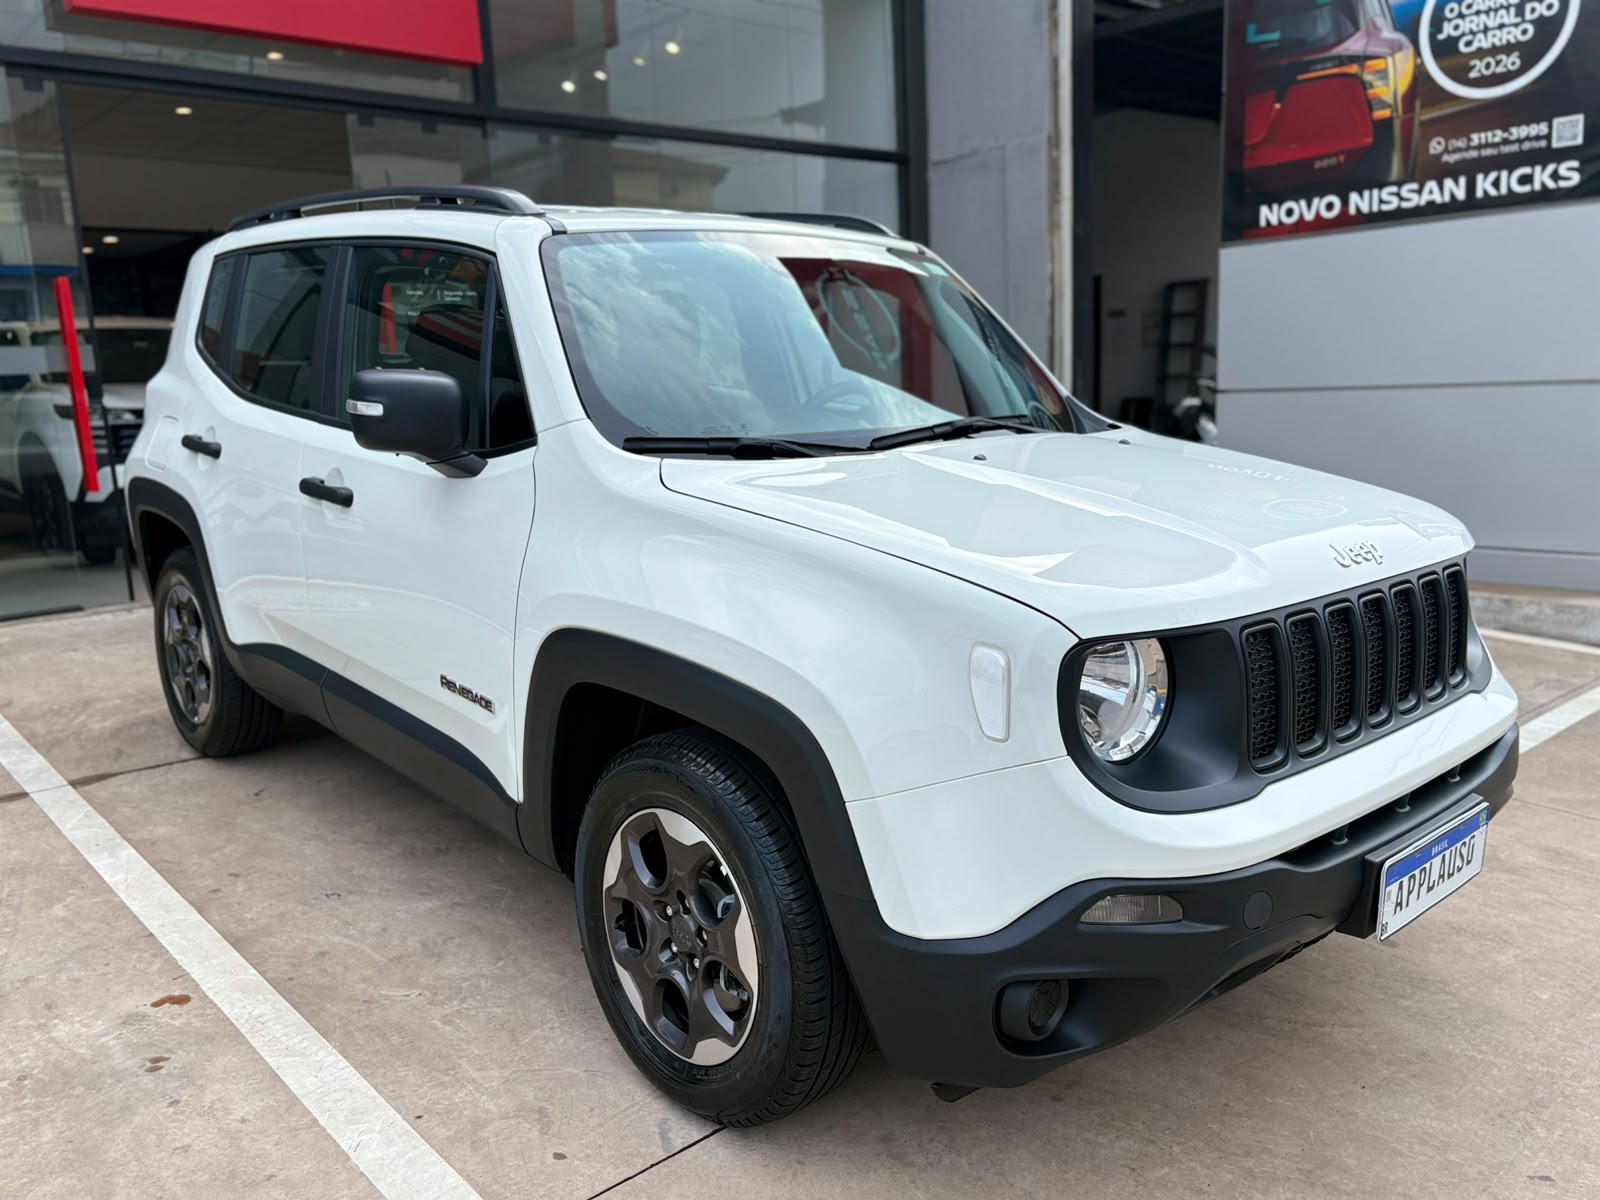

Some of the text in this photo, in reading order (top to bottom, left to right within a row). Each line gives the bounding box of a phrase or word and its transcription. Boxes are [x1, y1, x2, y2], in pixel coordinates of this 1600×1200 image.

[1436, 0, 1560, 40] JORNAL DO
[1444, 2, 1460, 19] O
[1457, 22, 1535, 53] CARRO
[1468, 51, 1521, 79] 2026
[1258, 160, 1581, 228] NOVO NISSAN KICKS
[1328, 540, 1384, 569] Jeep
[439, 673, 495, 715] RENEGADE
